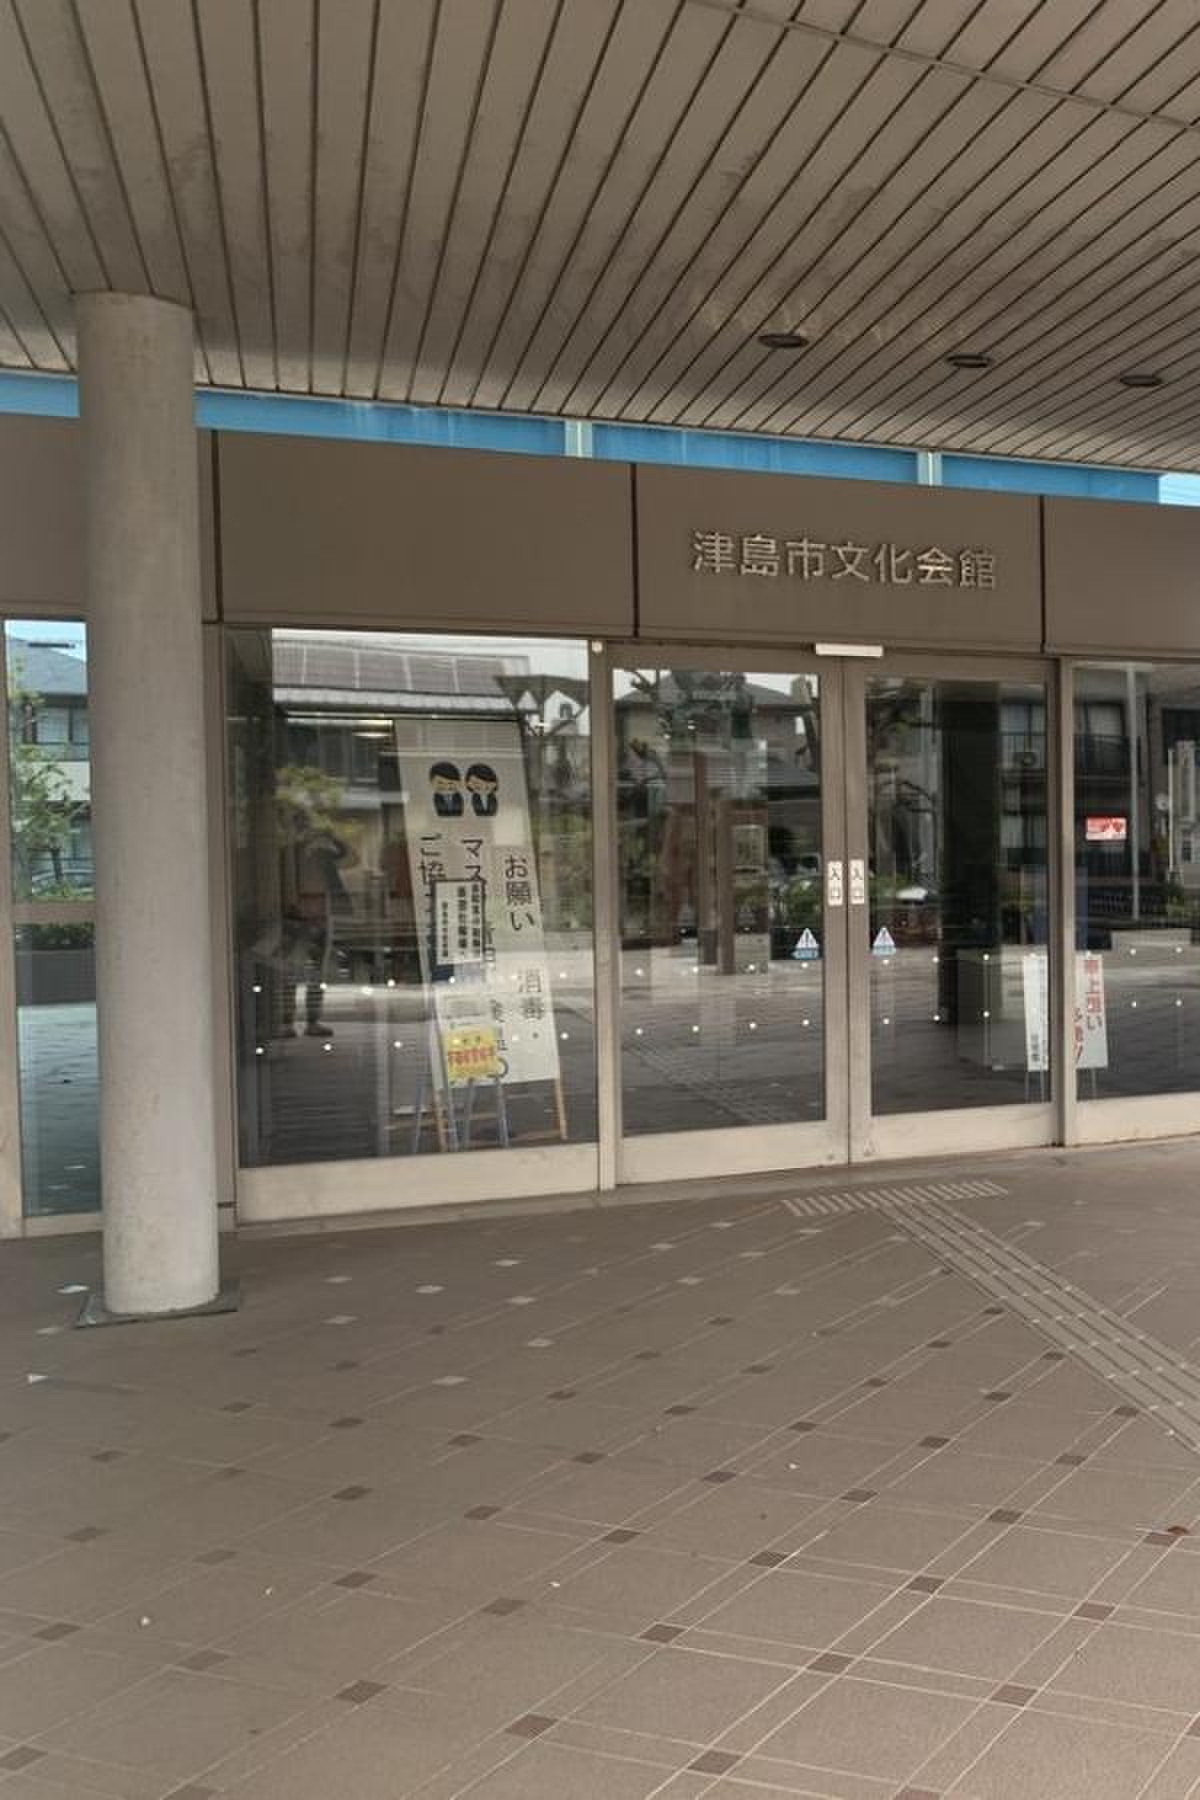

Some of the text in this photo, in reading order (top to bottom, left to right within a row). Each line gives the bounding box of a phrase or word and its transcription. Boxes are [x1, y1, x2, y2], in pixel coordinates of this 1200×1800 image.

[691, 529, 997, 591] 津島市文化会館
[504, 854, 535, 932] お願い
[829, 866, 843, 900] 入口
[851, 865, 865, 899] 入口
